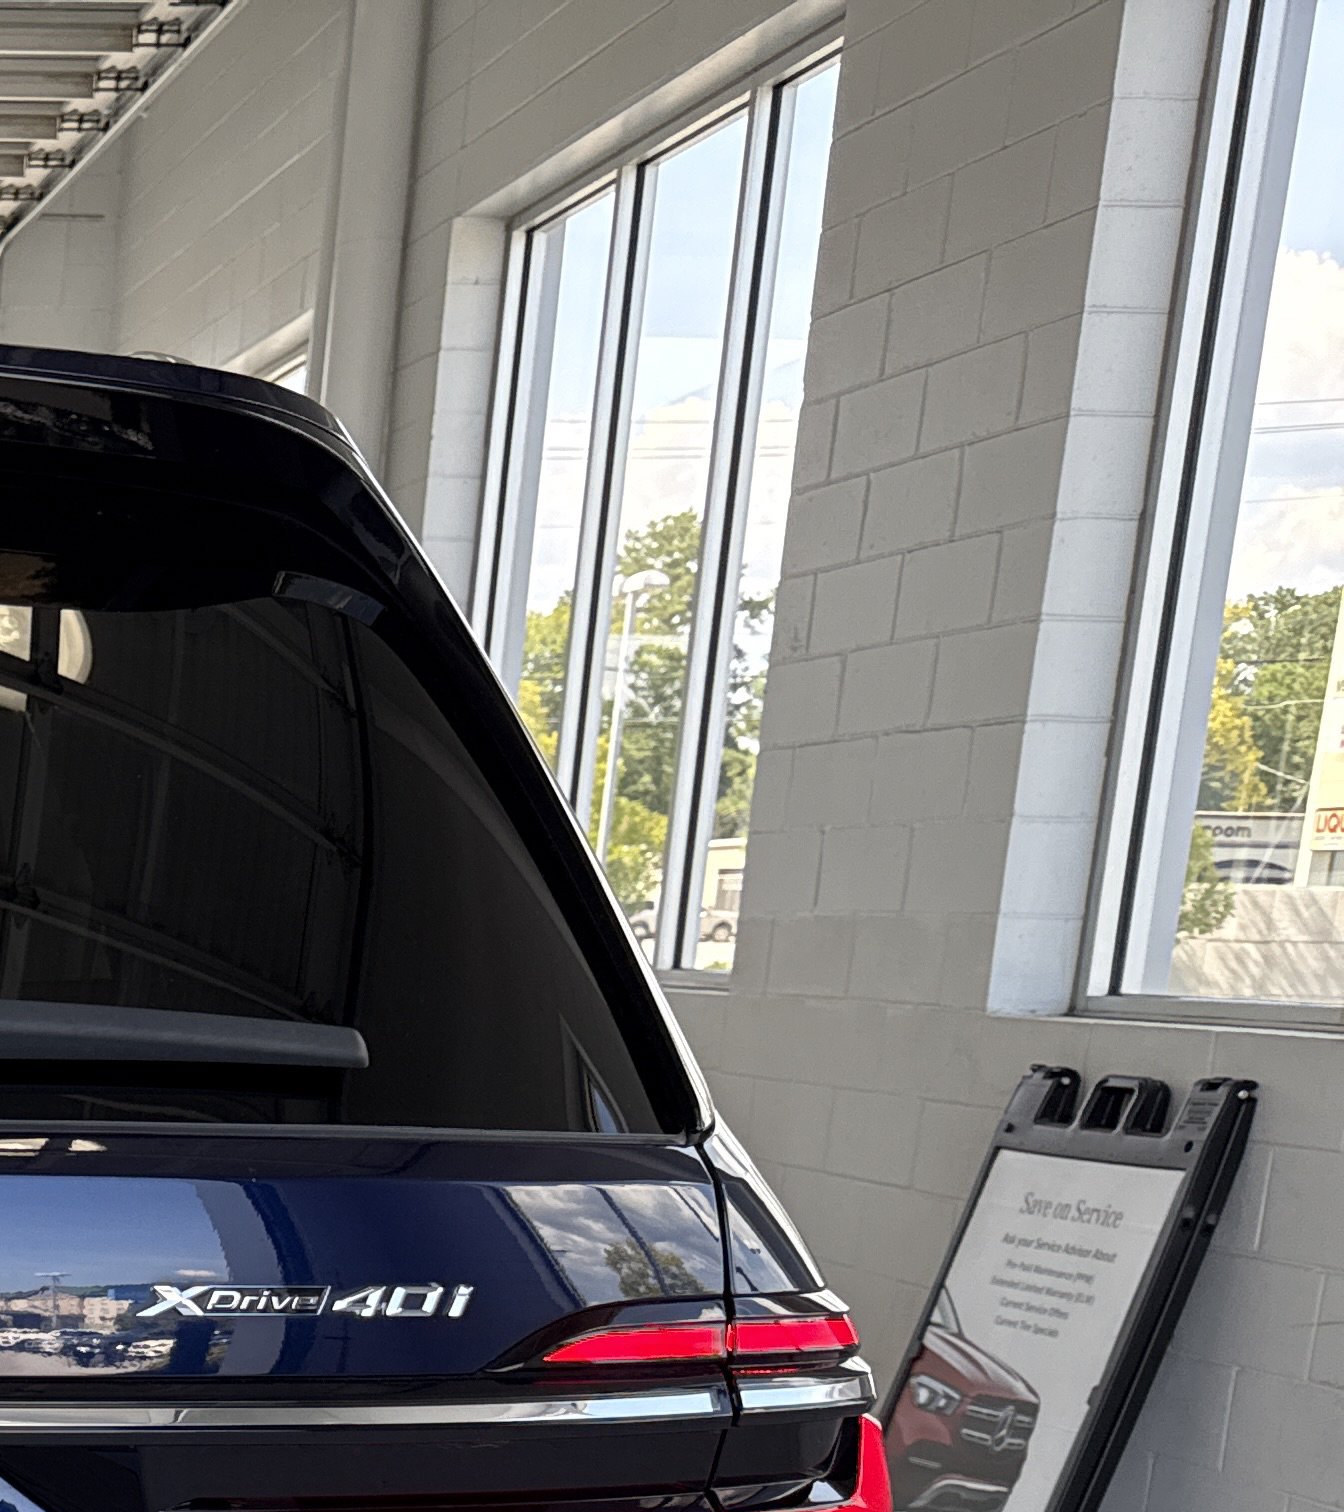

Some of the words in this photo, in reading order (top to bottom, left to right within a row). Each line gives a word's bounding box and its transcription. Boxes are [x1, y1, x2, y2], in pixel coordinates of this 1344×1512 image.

[1019, 1191, 1053, 1218] Save
[1052, 1200, 1072, 1221] on
[1070, 1199, 1124, 1229] Service
